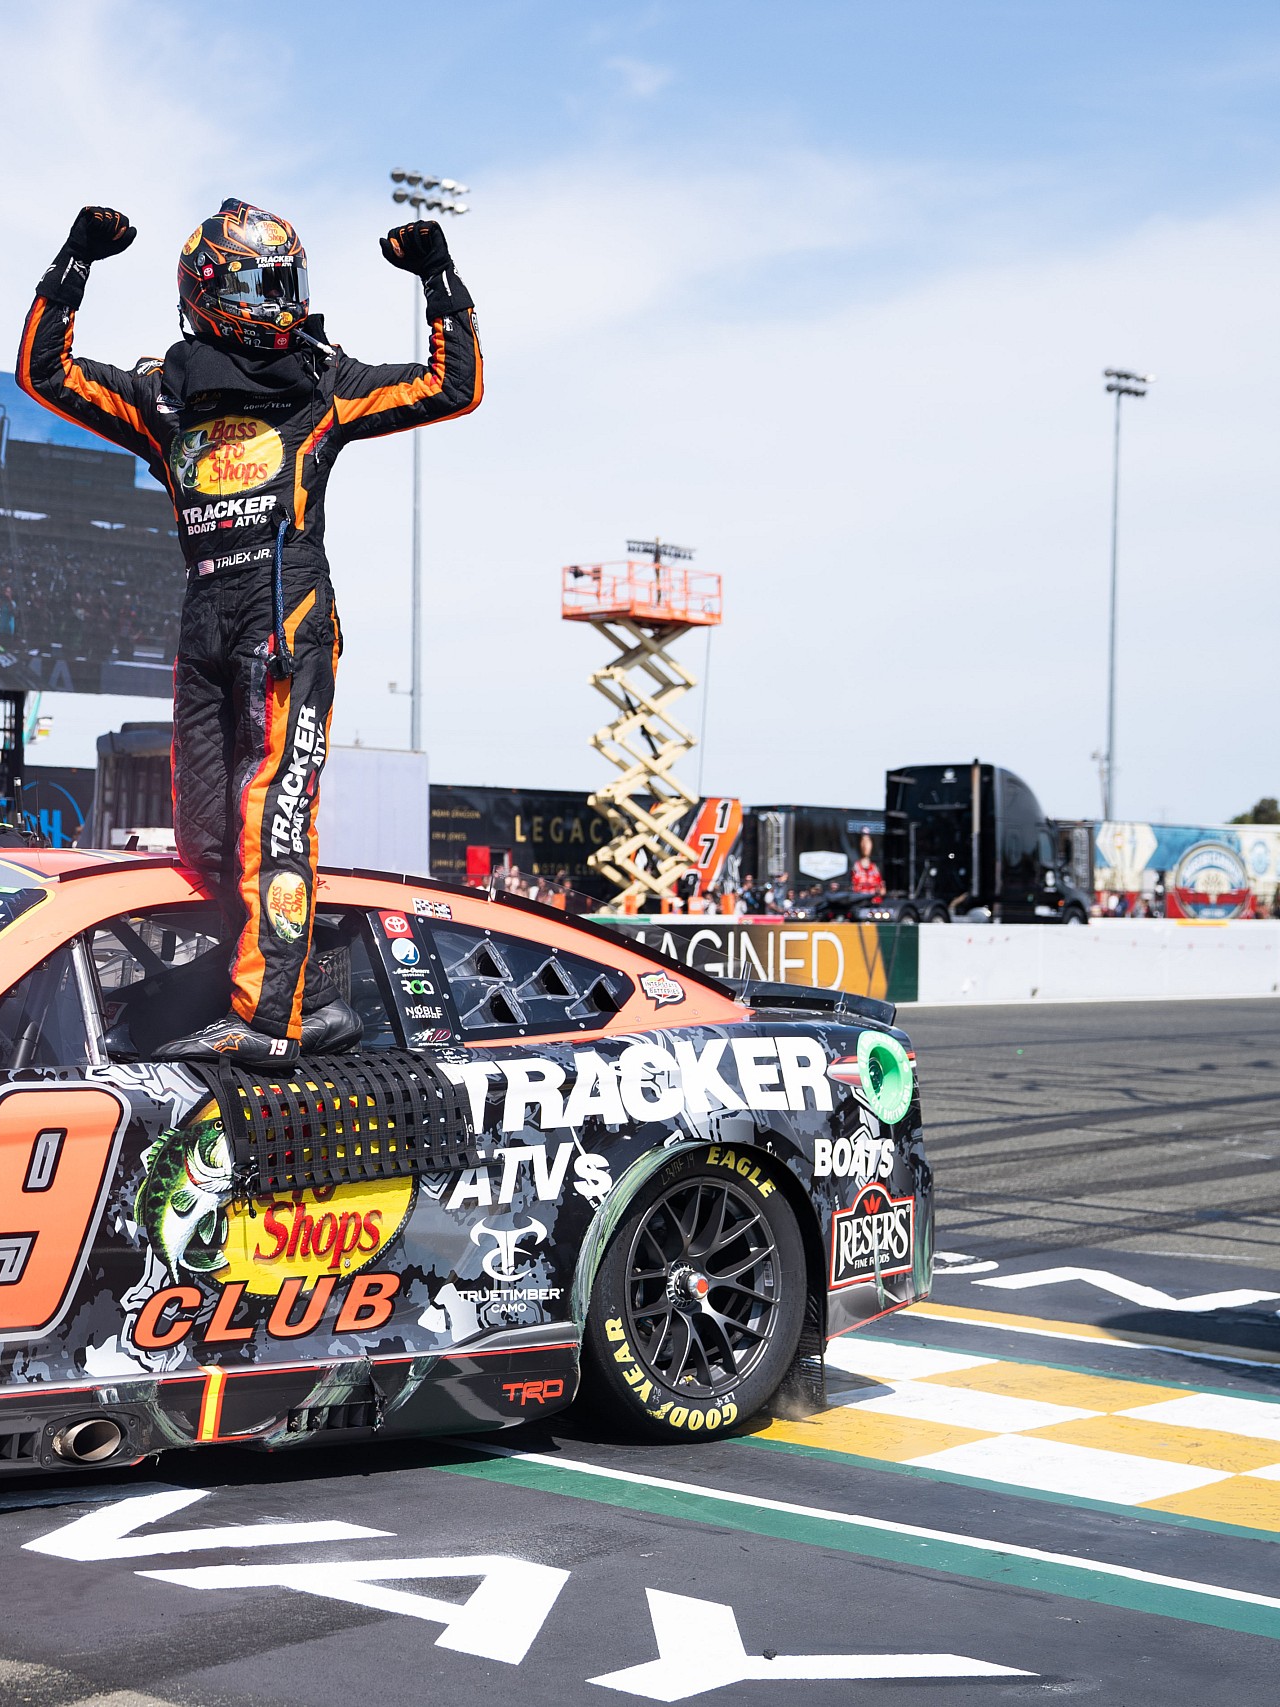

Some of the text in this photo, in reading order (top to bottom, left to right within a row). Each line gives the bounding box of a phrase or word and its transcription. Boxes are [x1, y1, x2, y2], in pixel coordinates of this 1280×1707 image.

[255, 255, 294, 264] TRACKER
[209, 420, 258, 440] Bass
[208, 440, 245, 460] Pro
[209, 460, 269, 485] Shops
[182, 495, 277, 525] TRACKER
[187, 514, 268, 536] BOATS ATVs
[216, 548, 273, 569] TRUEX JR.
[271, 703, 317, 858] TRACKER
[292, 795, 309, 854] BOATS
[514, 814, 619, 844] LEGACY
[269, 885, 281, 914] Bass
[280, 892, 294, 914] Pro
[292, 881, 306, 918] Shops
[645, 980, 678, 988] INTERSTATE
[649, 987, 680, 995] BATTERIES
[405, 1005, 443, 1016] NOBLE
[268, 1039, 288, 1056] 19
[437, 1036, 834, 1134] TRACKER
[813, 1138, 895, 1178] BOATS
[445, 1142, 613, 1211] ATVs
[706, 1146, 777, 1199] EAGLE
[253, 1201, 384, 1271] Shops
[838, 1204, 911, 1279] RESER'S
[854, 1255, 869, 1270] FINE
[458, 1288, 562, 1302] TRUETIMBER
[491, 1302, 528, 1314] CAMO
[132, 1273, 401, 1351] CLUB
[604, 1316, 738, 1431] GOODYEAR
[503, 1379, 564, 1406] TRD
